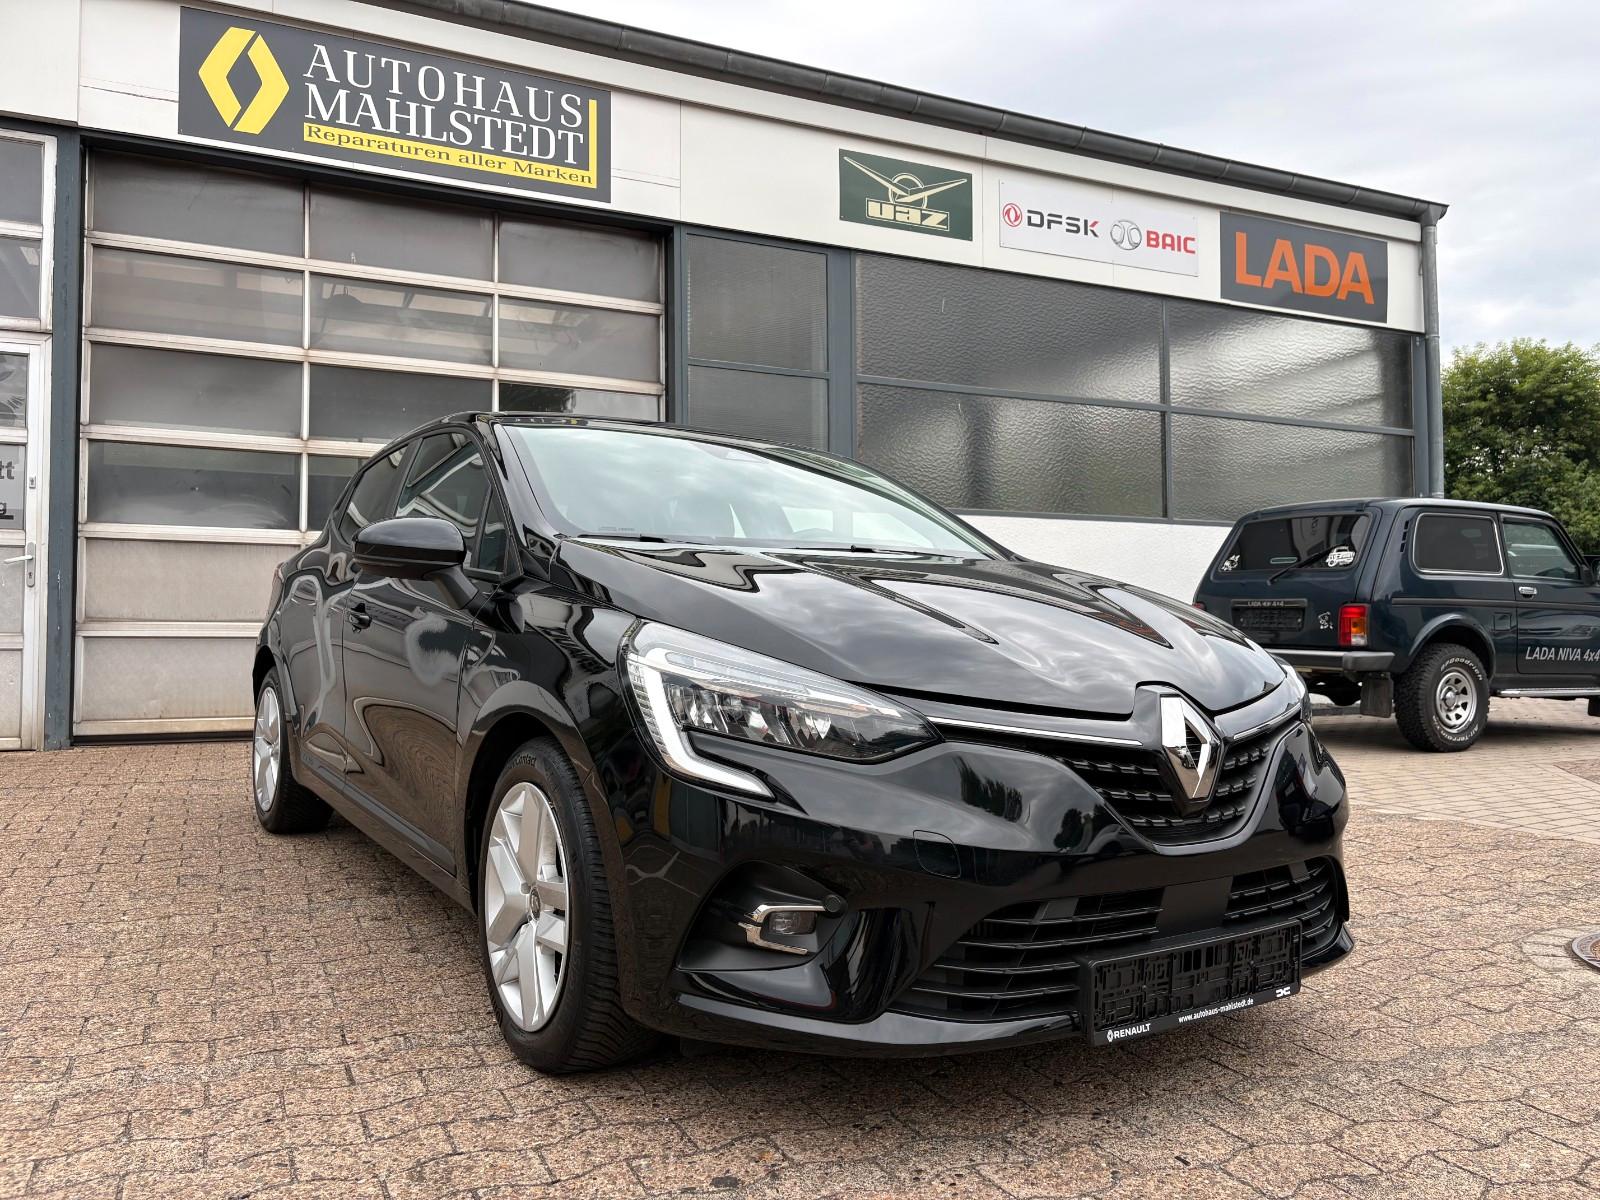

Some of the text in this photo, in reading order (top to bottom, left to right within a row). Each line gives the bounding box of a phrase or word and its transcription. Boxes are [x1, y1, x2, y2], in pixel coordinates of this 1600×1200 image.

[303, 43, 583, 129] AUTOHAUS
[304, 83, 584, 166] MAHLSTEDT
[306, 125, 593, 185] Reparaturen aller Marken
[1026, 208, 1100, 238] DFSK
[1146, 230, 1196, 255] BAIC
[1234, 231, 1375, 305] LADA
[1525, 646, 1555, 660] LADA
[1557, 647, 1581, 661] NIVA
[1178, 998, 1254, 1024] www.autohaus-mahlstedt.de
[1113, 1023, 1151, 1040] RENAULT
